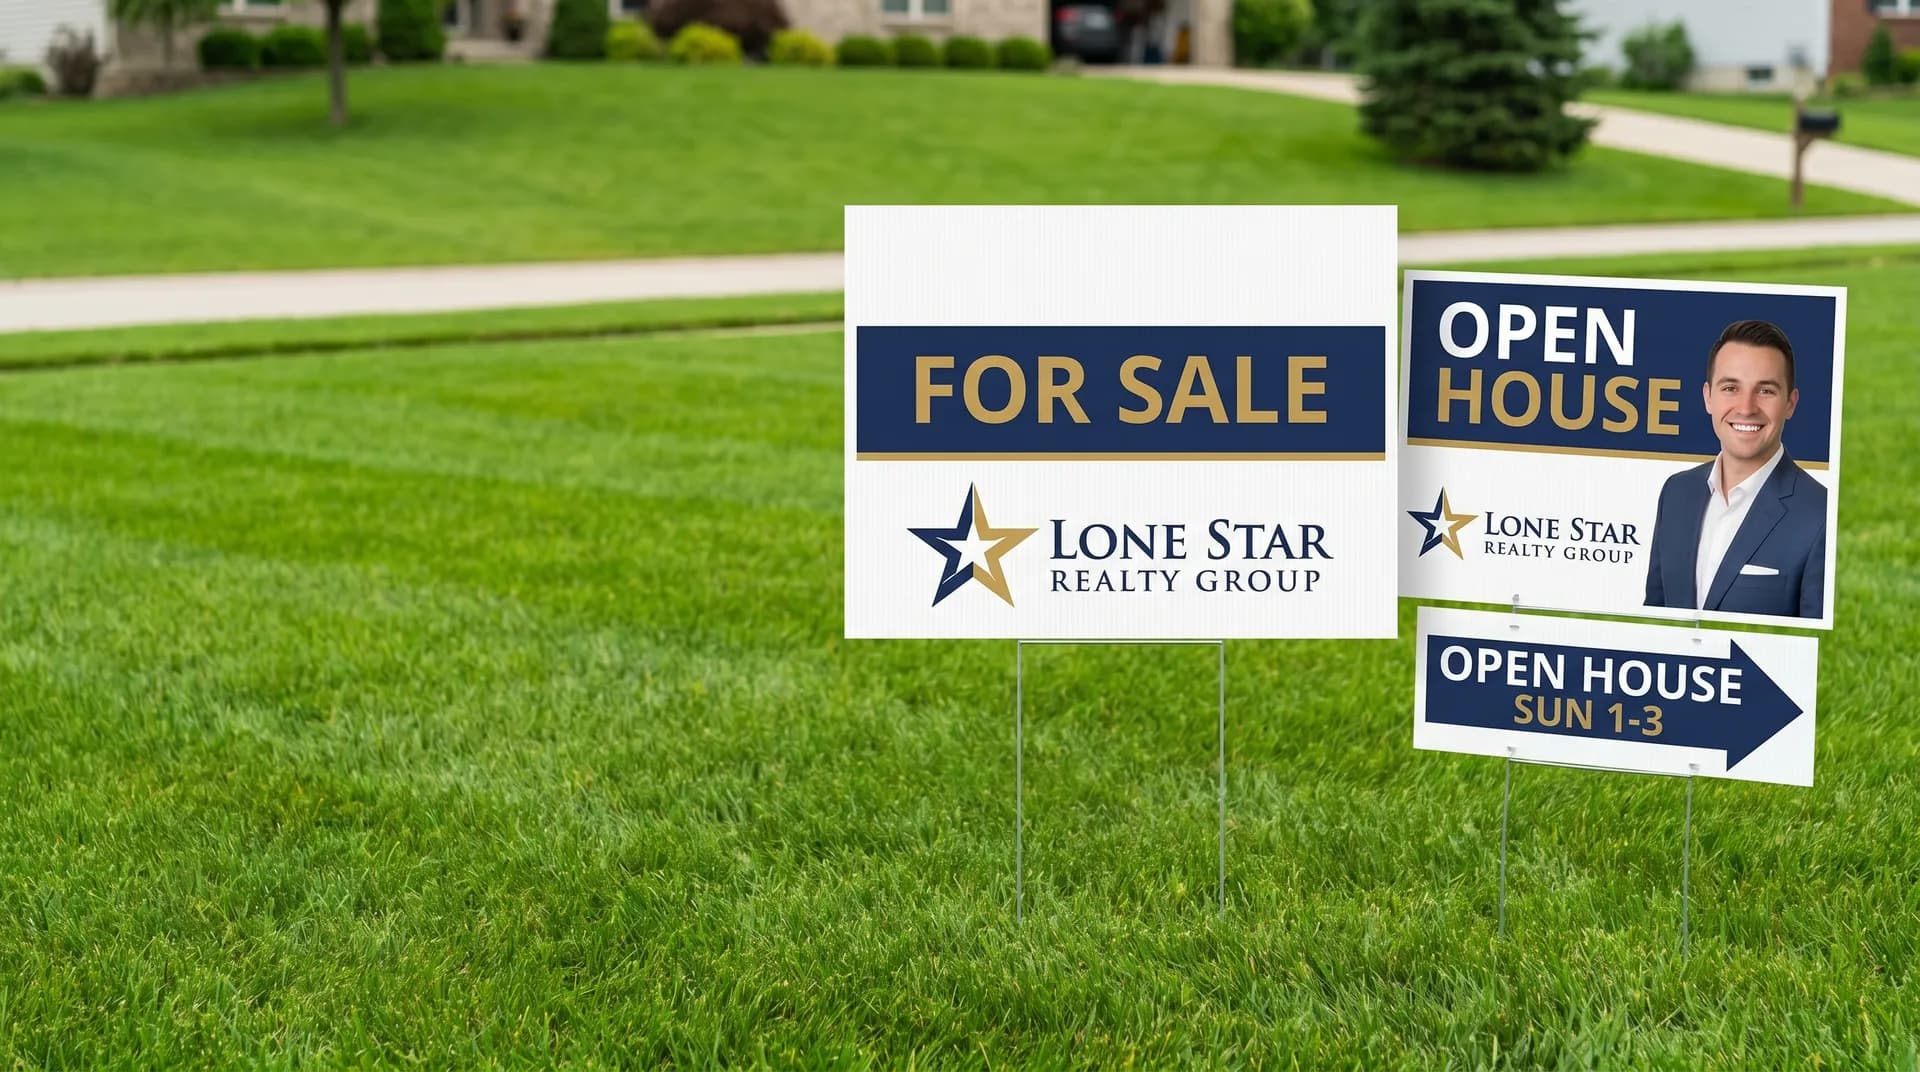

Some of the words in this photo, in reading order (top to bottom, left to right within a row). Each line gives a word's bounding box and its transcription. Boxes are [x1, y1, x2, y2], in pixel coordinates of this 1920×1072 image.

[1438, 301, 1635, 365] OPEN
[915, 355, 1091, 423] FOR
[1118, 354, 1327, 423] SALE
[1437, 367, 1681, 434] HOUSE
[1050, 570, 1180, 592] REALTY
[1196, 570, 1320, 592] GROUP
[1484, 541, 1555, 558] REALTY
[1563, 546, 1633, 563] GROUP
[1439, 645, 1564, 688] OPEN
[1582, 657, 1742, 704] HOUSE
[1513, 694, 1592, 729] SUN
[1608, 704, 1662, 736] 1-3
